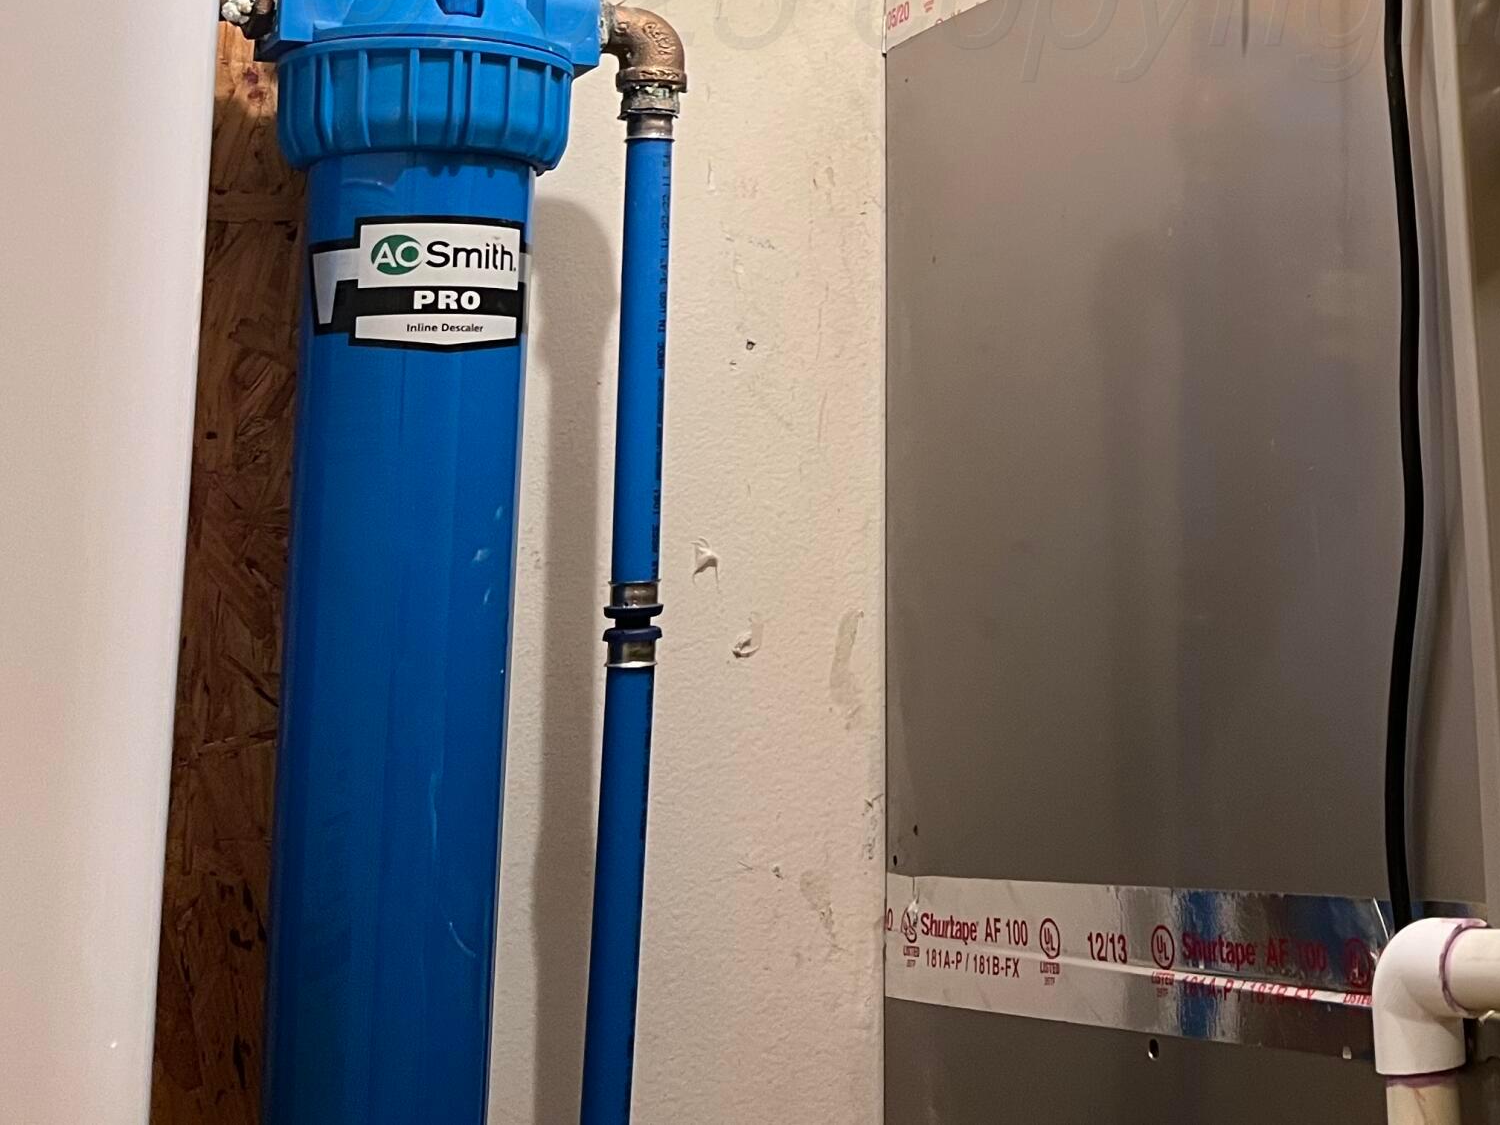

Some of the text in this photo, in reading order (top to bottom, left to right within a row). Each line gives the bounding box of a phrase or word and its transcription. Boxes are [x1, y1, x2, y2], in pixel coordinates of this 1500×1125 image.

[426, 241, 515, 272] Smith
[413, 291, 481, 310] PRO
[407, 324, 484, 333] Inline Descaler
[920, 911, 979, 945] Shurtape
[984, 917, 1002, 943] AF
[1006, 919, 1028, 947] 100
[1087, 930, 1128, 964] 12/13
[1181, 931, 1257, 972] Shurtape
[1266, 937, 1290, 968] AF
[925, 948, 963, 971] 181A-P
[973, 954, 1020, 979] 181B-FX
